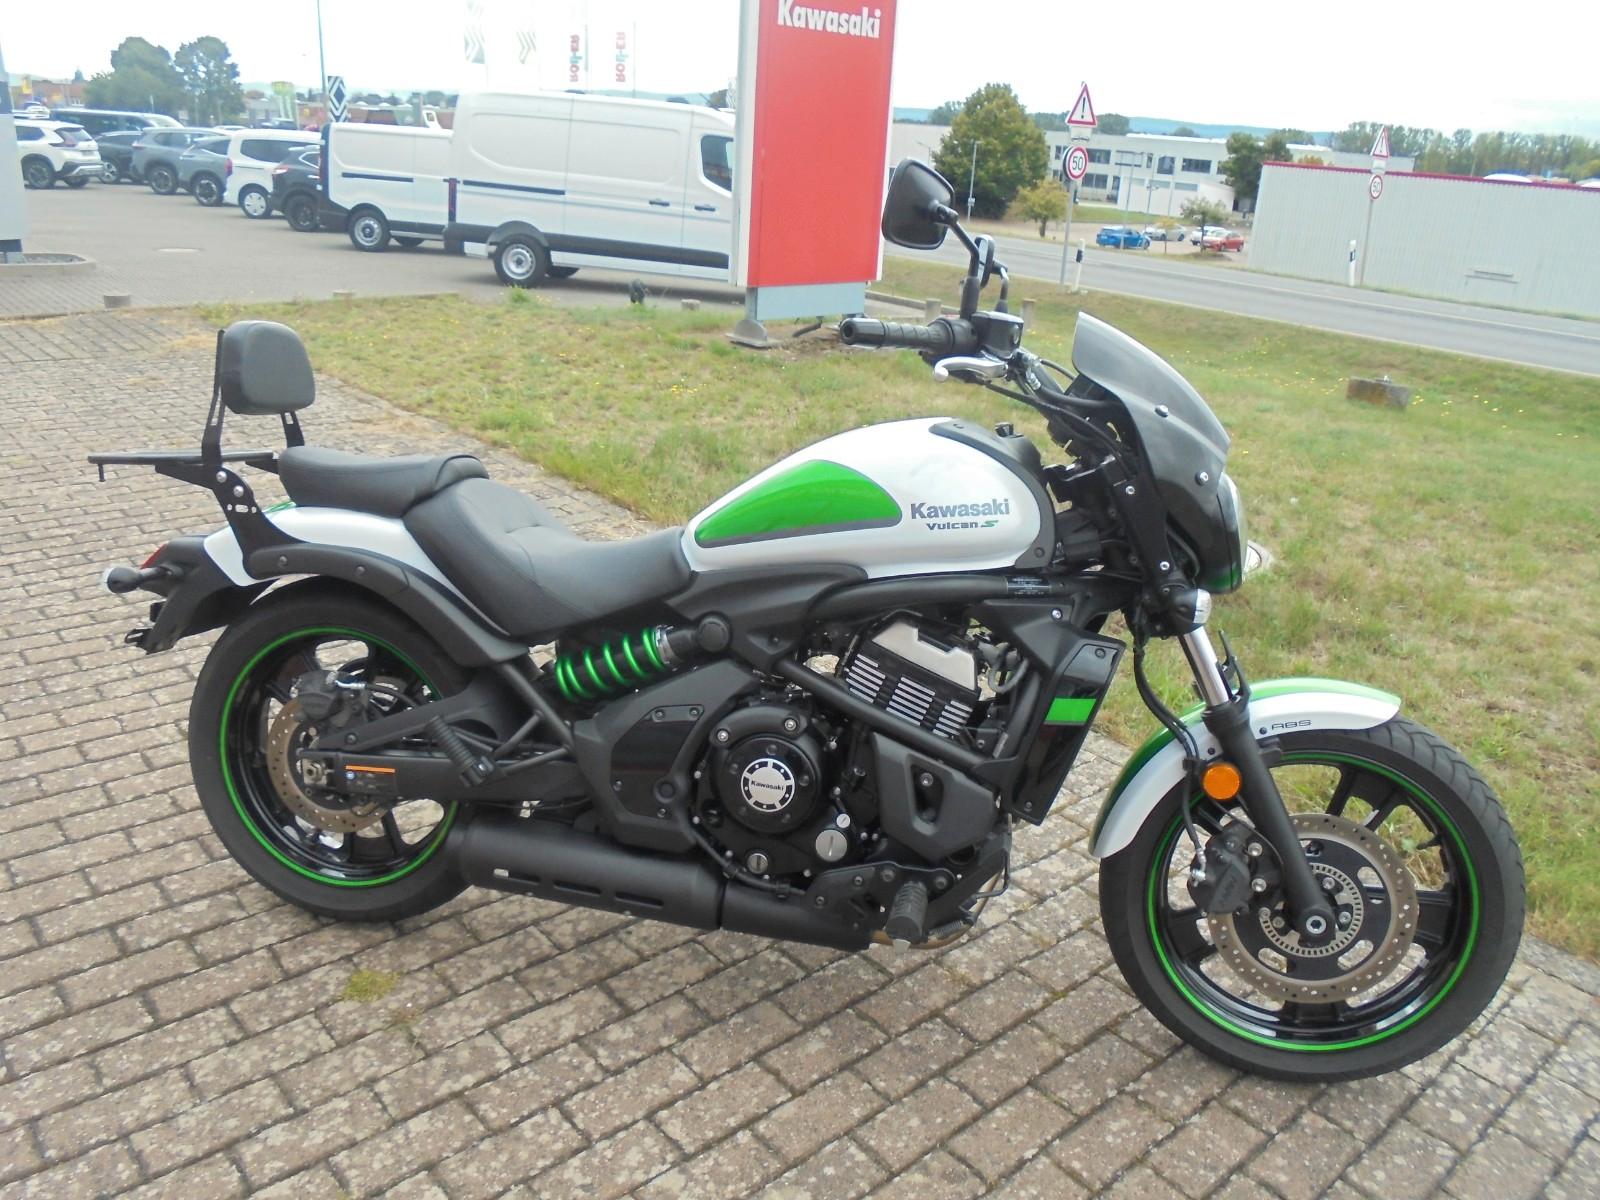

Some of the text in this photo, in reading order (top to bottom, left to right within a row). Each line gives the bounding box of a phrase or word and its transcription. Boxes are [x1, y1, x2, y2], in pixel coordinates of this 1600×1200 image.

[778, 0, 881, 38] Kawasaki
[1072, 156, 1084, 170] 50
[910, 498, 1010, 520] Kawasaki
[980, 519, 999, 528] S
[1271, 720, 1312, 730] ABS
[751, 780, 784, 791] Kawasaki
